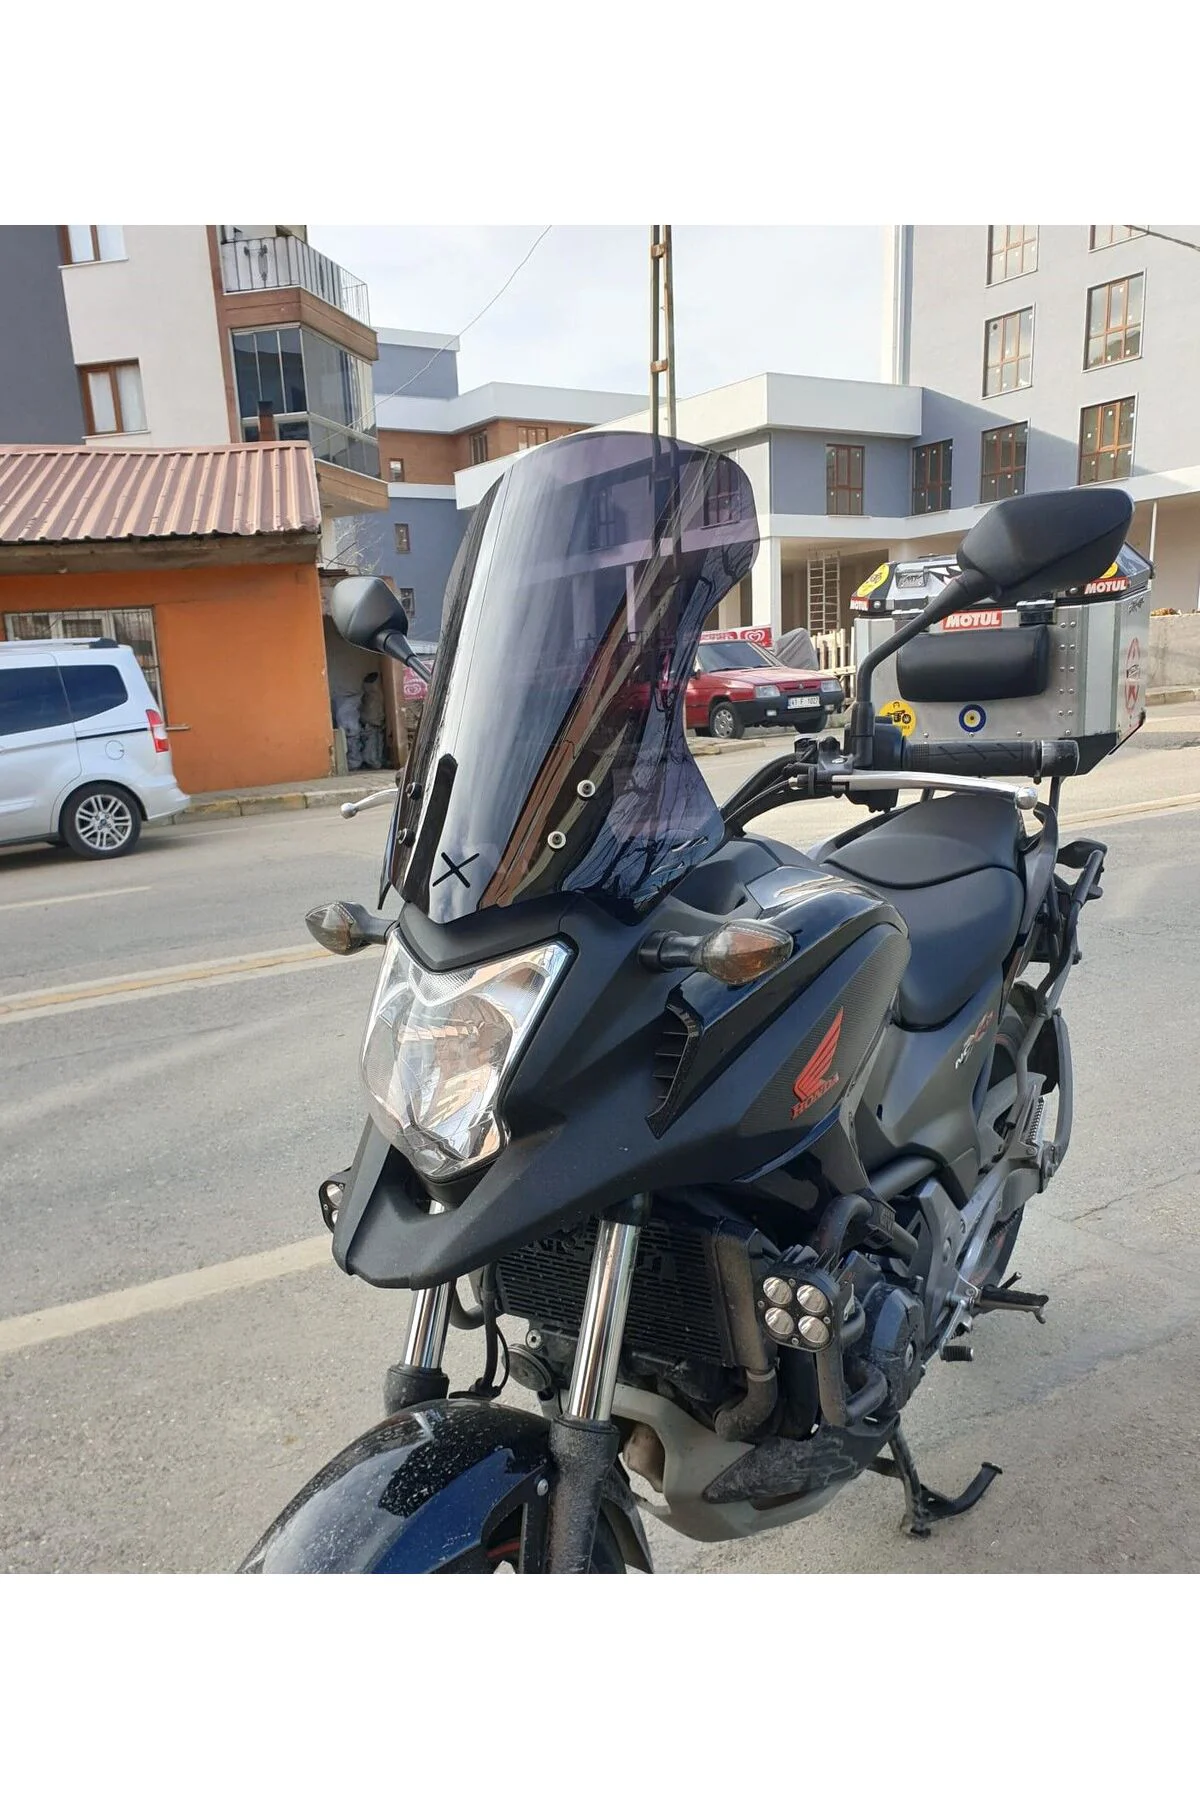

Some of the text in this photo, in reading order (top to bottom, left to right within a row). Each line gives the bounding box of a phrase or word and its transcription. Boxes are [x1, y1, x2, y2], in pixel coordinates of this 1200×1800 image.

[1084, 579, 1127, 595] MOTUL
[945, 610, 1001, 628] MOTUL
[790, 1072, 840, 1121] HONDA
